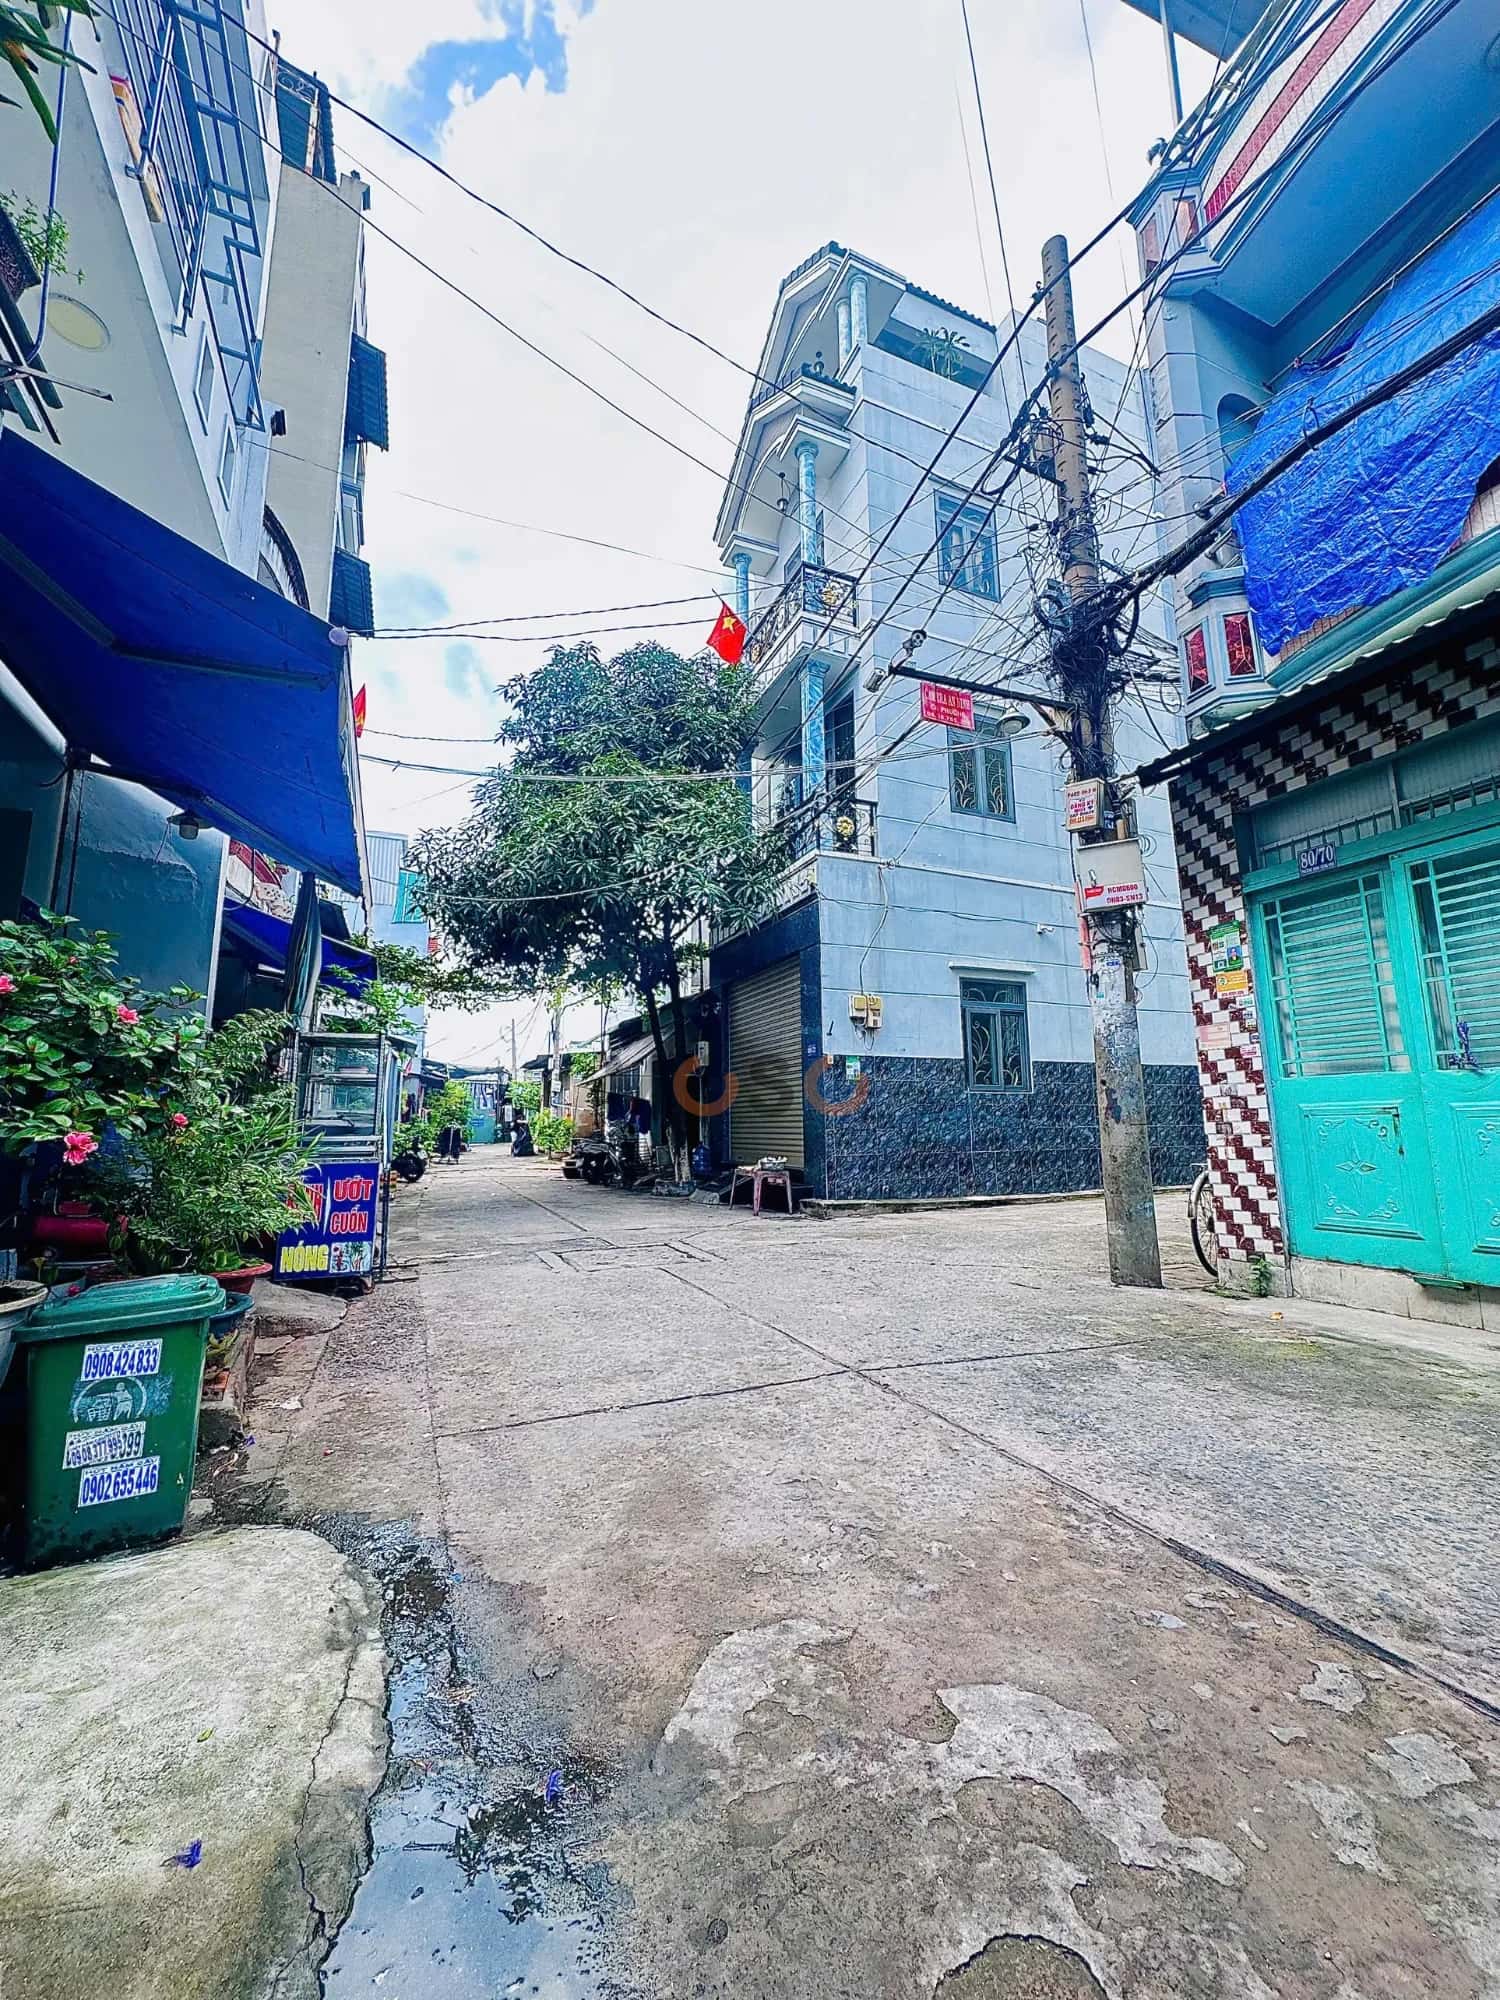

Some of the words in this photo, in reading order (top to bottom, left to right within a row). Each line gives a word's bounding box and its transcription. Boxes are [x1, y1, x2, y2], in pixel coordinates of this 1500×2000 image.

[1300, 845, 1334, 869] 80/70
[330, 1204, 368, 1234] CUỐN
[280, 1240, 329, 1273] NÓNG
[84, 1348, 158, 1378] 0908.424.833
[82, 1464, 158, 1504] 0902.655.446
